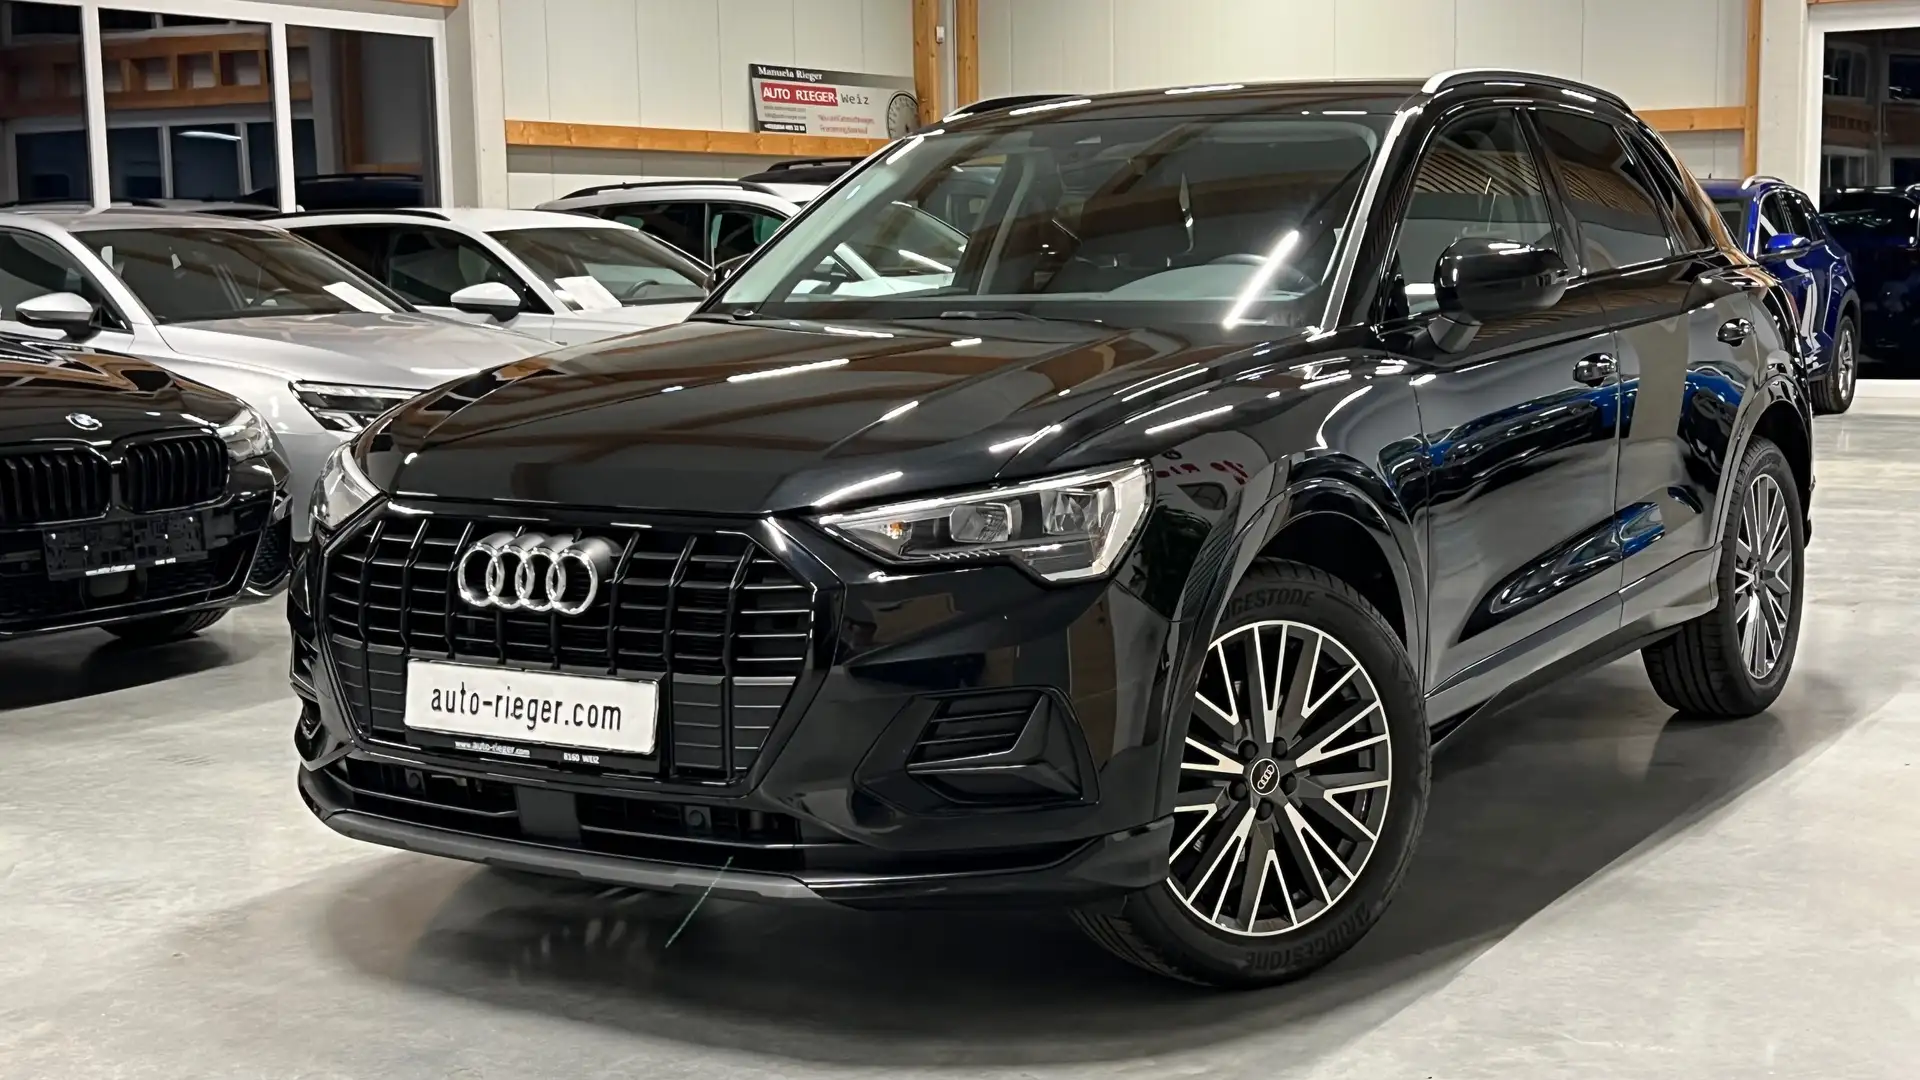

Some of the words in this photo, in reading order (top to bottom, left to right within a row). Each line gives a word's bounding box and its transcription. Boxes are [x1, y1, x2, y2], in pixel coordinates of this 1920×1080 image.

[758, 66, 794, 78] Manuela
[796, 70, 822, 82] Rieger
[763, 86, 790, 99] AUTO
[841, 93, 869, 105] Weiz
[431, 681, 622, 731] auto-rieger.com
